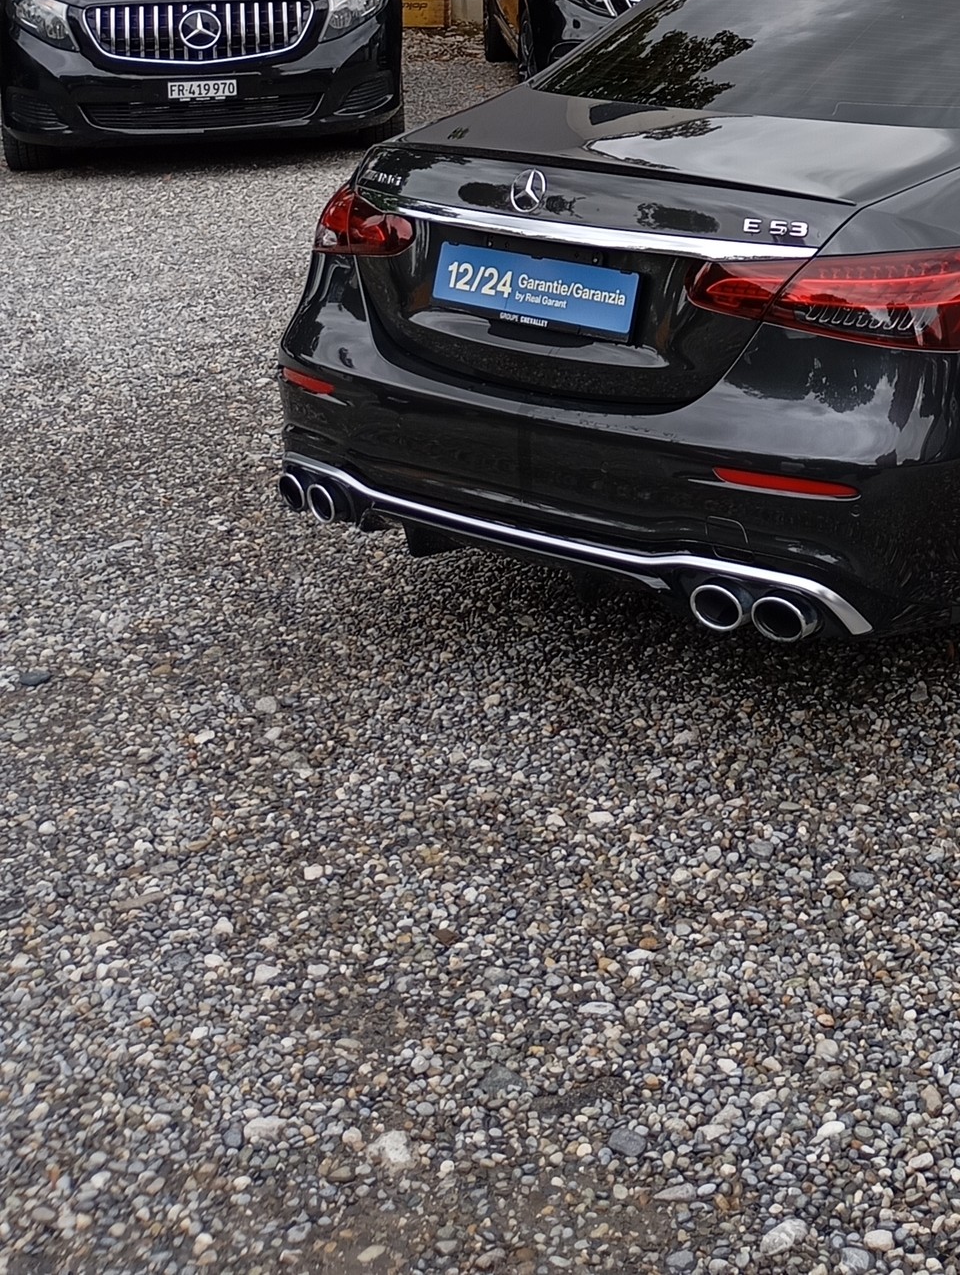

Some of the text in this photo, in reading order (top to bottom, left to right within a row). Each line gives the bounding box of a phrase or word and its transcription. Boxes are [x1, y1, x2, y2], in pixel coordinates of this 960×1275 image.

[743, 218, 808, 237] E 53
[448, 261, 626, 306] 12/24 Garantie/Garanzia
[515, 290, 567, 309] by Real Garant
